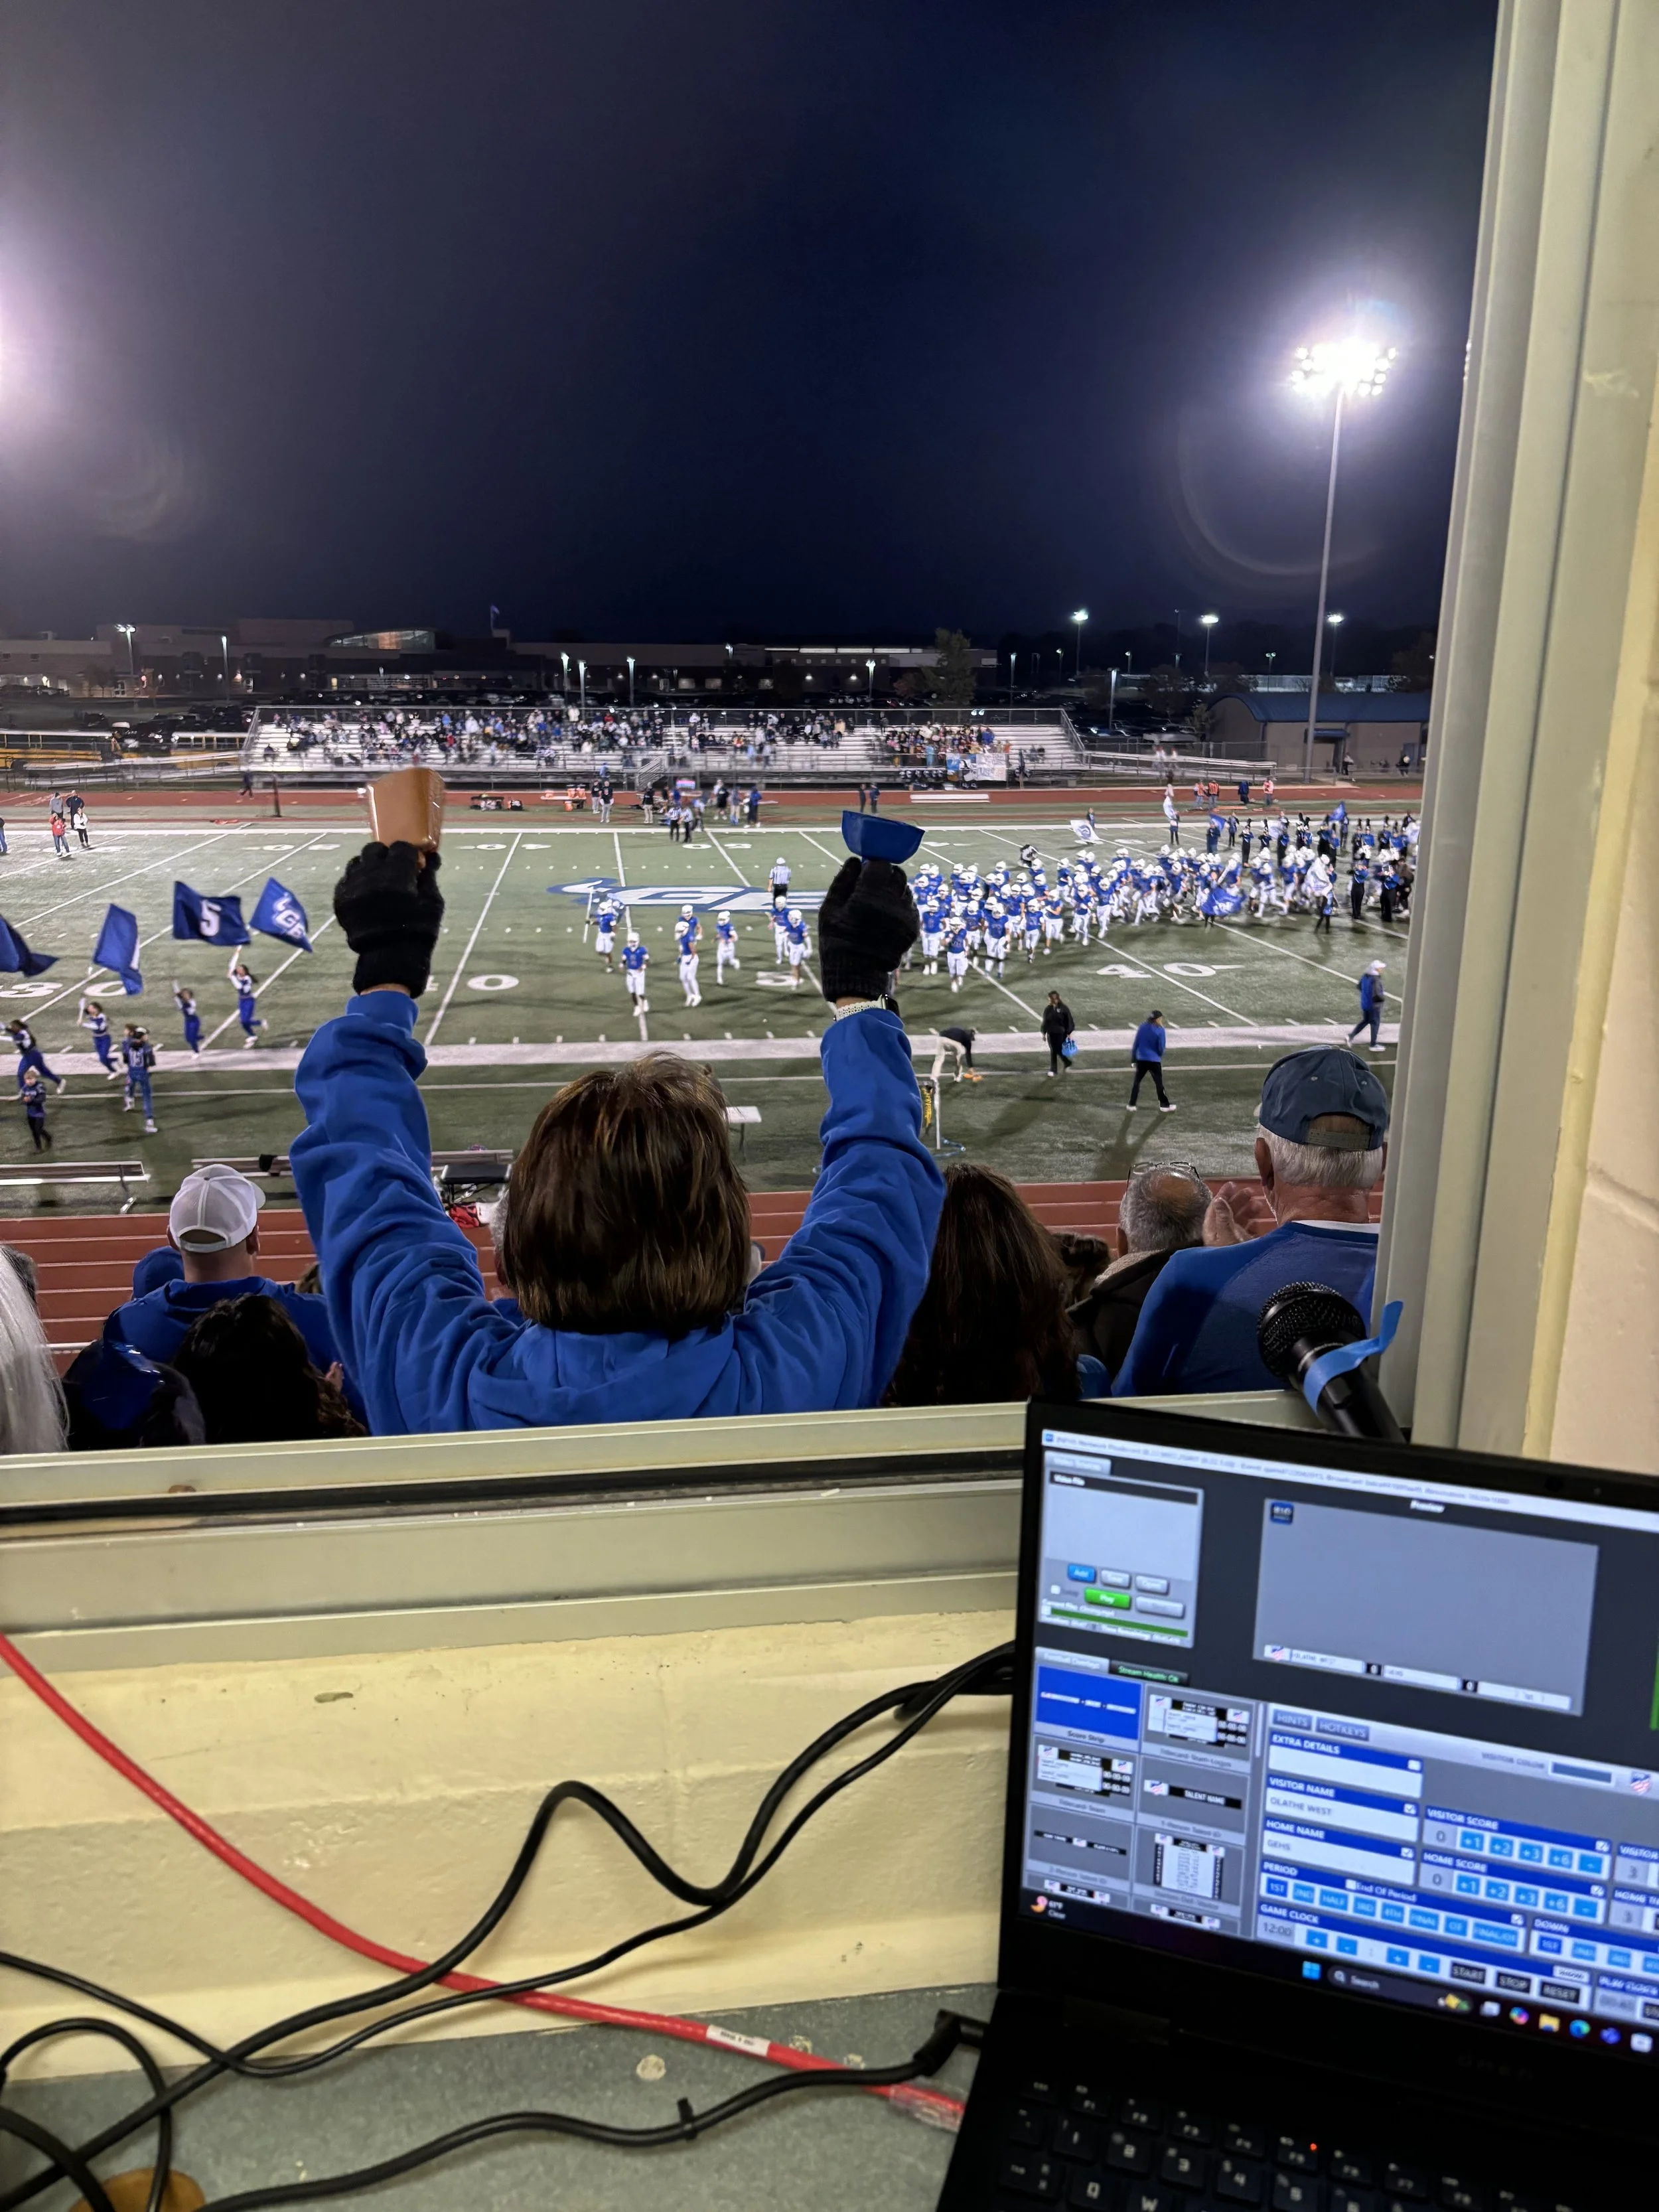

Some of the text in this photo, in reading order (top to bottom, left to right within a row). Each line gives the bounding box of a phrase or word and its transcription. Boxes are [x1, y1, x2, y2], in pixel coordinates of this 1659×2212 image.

[200, 900, 222, 937] 5
[1096, 962, 1216, 978] 40
[1118, 1665, 1143, 1676] Stream
[1276, 1711, 1308, 1728] HINTS
[1319, 1720, 1367, 1737] HOTKEYS
[1066, 1730, 1106, 1744] Score Strip
[1272, 1733, 1341, 1755] EXTRA DETAILS
[1269, 1776, 1336, 1799] VISITOR NAME
[1185, 1789, 1226, 1805] TALENT NAME
[1269, 1796, 1333, 1816] OLATHE WEST
[1426, 1808, 1500, 1830] VISITOR SCORE
[1265, 1819, 1326, 1840] HOME NAME
[1436, 1830, 1446, 1843] 0
[1267, 1839, 1291, 1852] GEHS
[1463, 1836, 1481, 1849] +1
[1492, 1842, 1512, 1855] +2
[1522, 1847, 1541, 1860] +3
[1263, 1861, 1299, 1877] PERIOD
[1423, 1851, 1488, 1873] HOME SCORE
[1269, 1881, 1285, 1893] 1ST
[1433, 1873, 1443, 1886] 0
[1459, 1880, 1477, 1893] +1
[1356, 1881, 1419, 1903] End Of Period
[1488, 1885, 1506, 1898] +2
[1322, 1893, 1346, 1907] HALF
[1260, 1903, 1320, 1925] GAME CLOCK
[1262, 1921, 1293, 1937] 12:00
[1452, 1964, 1484, 1980] START
[1350, 1975, 1380, 1990] Search
[1177, 2157, 1191, 2173] 3
[1232, 2171, 1247, 2187] 4
[1085, 2179, 1102, 2200] Q
[1139, 2194, 1160, 2212] W
